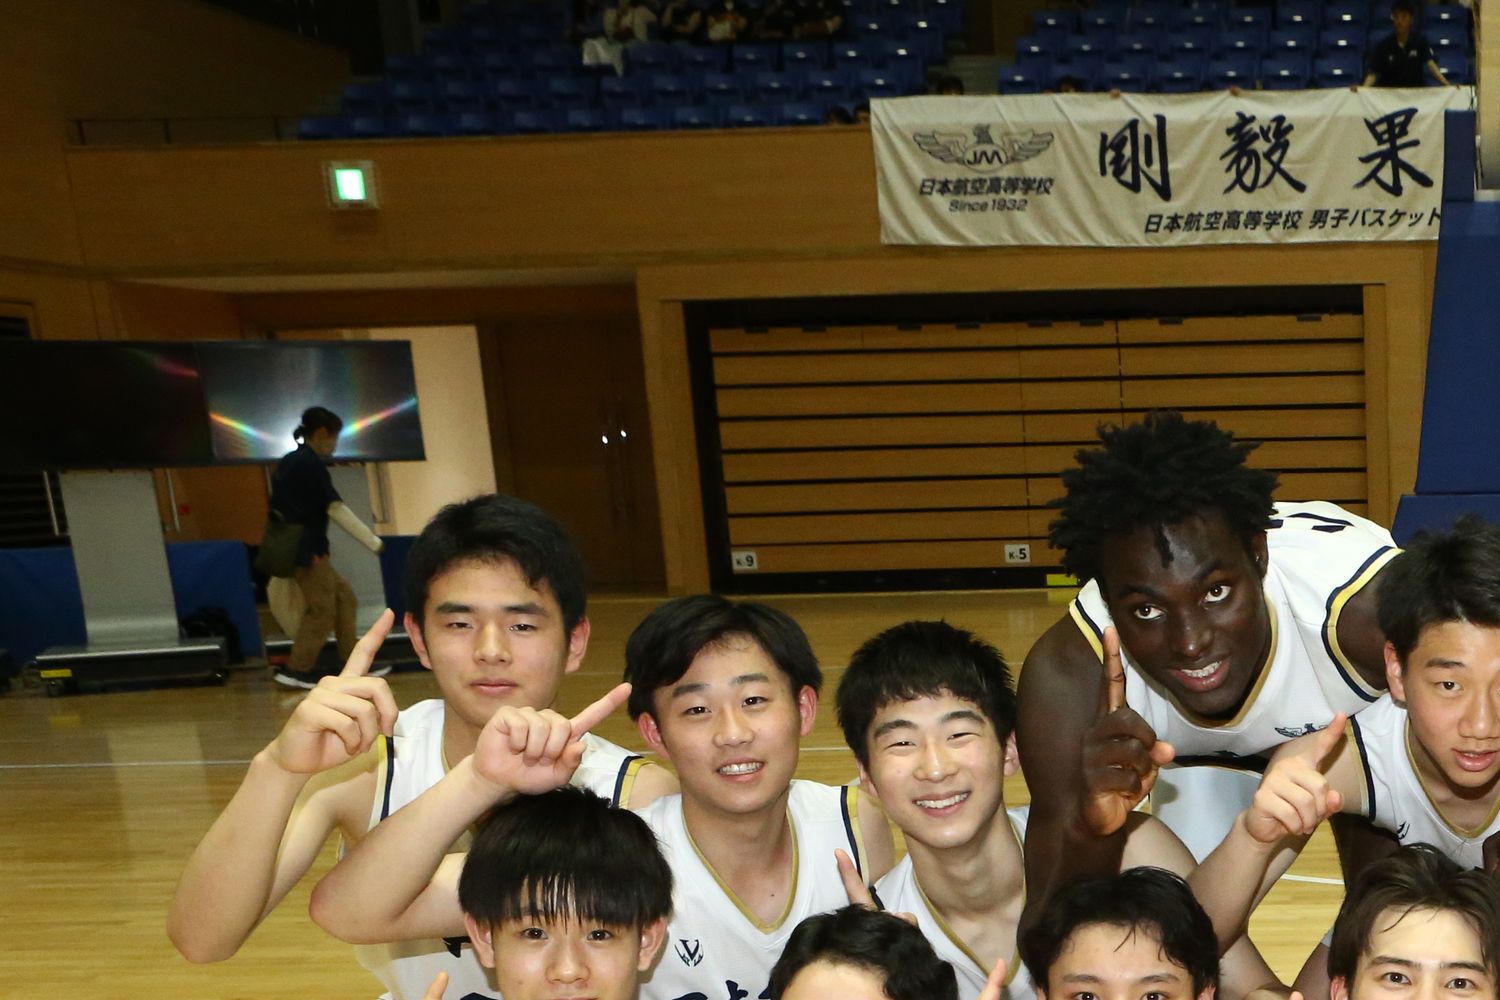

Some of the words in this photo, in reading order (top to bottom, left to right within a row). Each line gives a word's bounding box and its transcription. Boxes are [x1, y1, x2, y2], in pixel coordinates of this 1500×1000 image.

[919, 176, 1055, 196] 日本航空高等学校
[991, 198, 1027, 211] 1932
[1144, 211, 1303, 234] 日本航空高等学校
